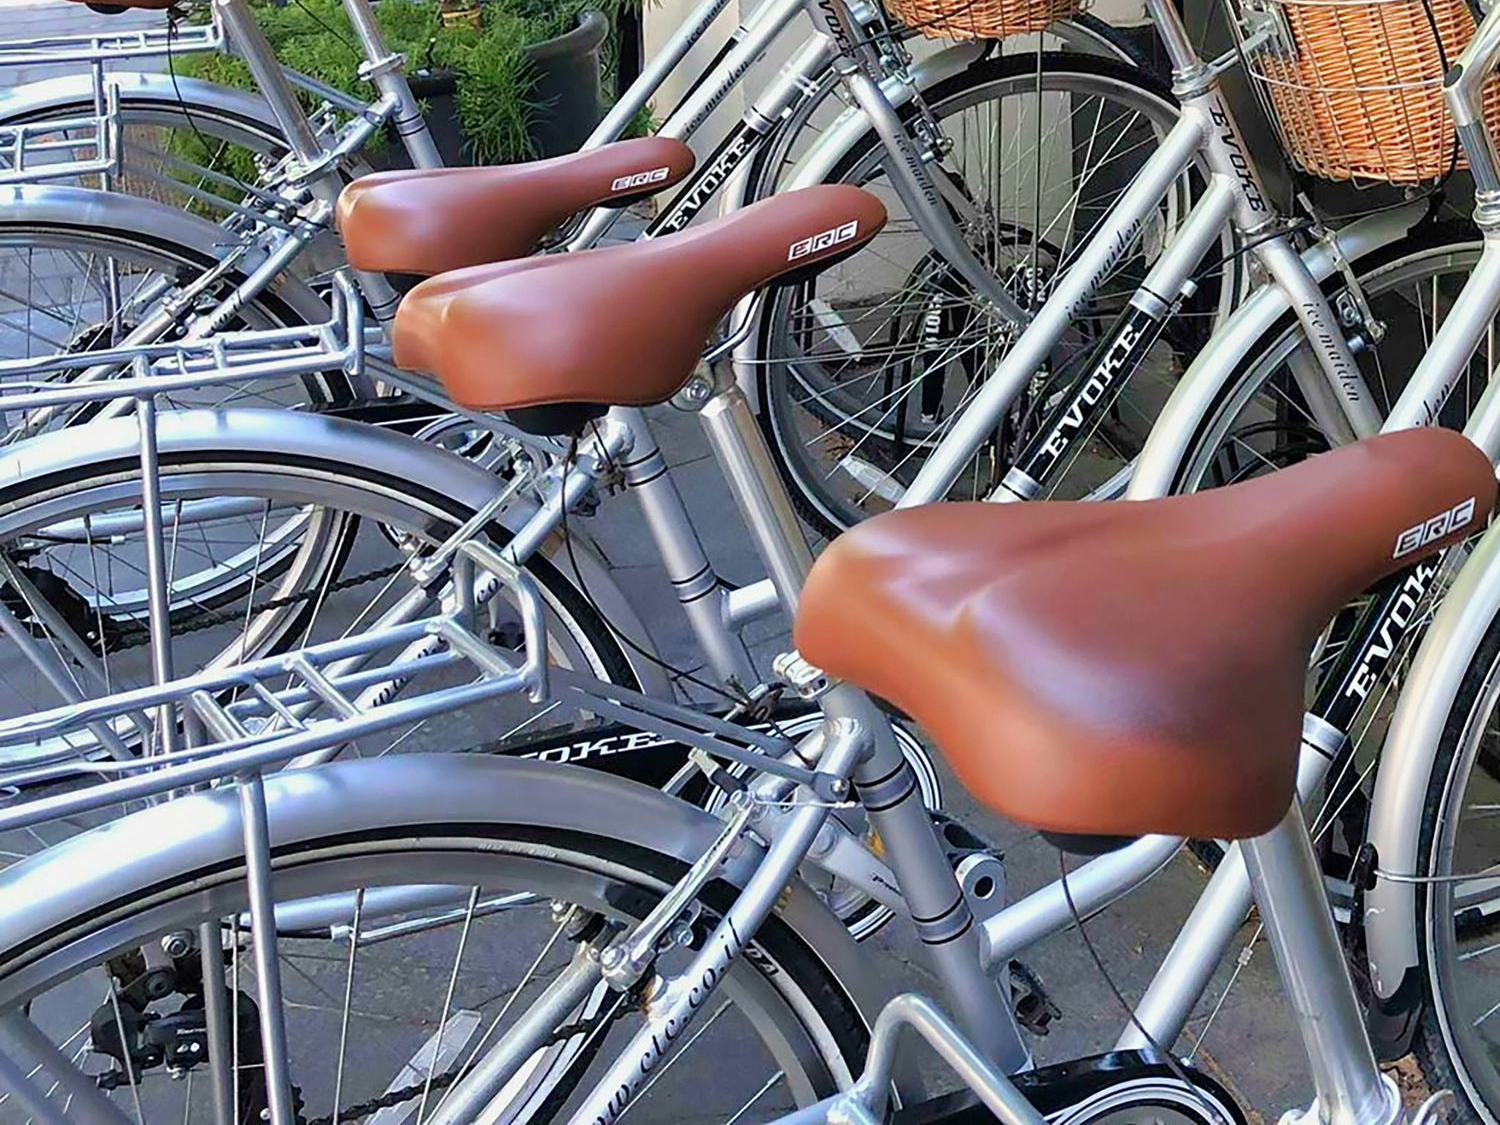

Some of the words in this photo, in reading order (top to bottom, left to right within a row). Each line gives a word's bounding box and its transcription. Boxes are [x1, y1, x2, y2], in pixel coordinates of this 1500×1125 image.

[704, 59, 750, 114] maiden
[664, 137, 751, 231] EVOKE
[893, 134, 910, 153] ice
[905, 156, 938, 206] maiden
[1208, 104, 1268, 213] EVOKE
[788, 220, 857, 261] ERC
[1090, 217, 1142, 292] maiden
[1303, 302, 1325, 328] ice
[1319, 334, 1361, 402] maiden
[1039, 323, 1142, 461] EVOKE
[1392, 496, 1476, 559] ERC
[1345, 547, 1448, 702] EVOK
[518, 731, 664, 765] OKE
